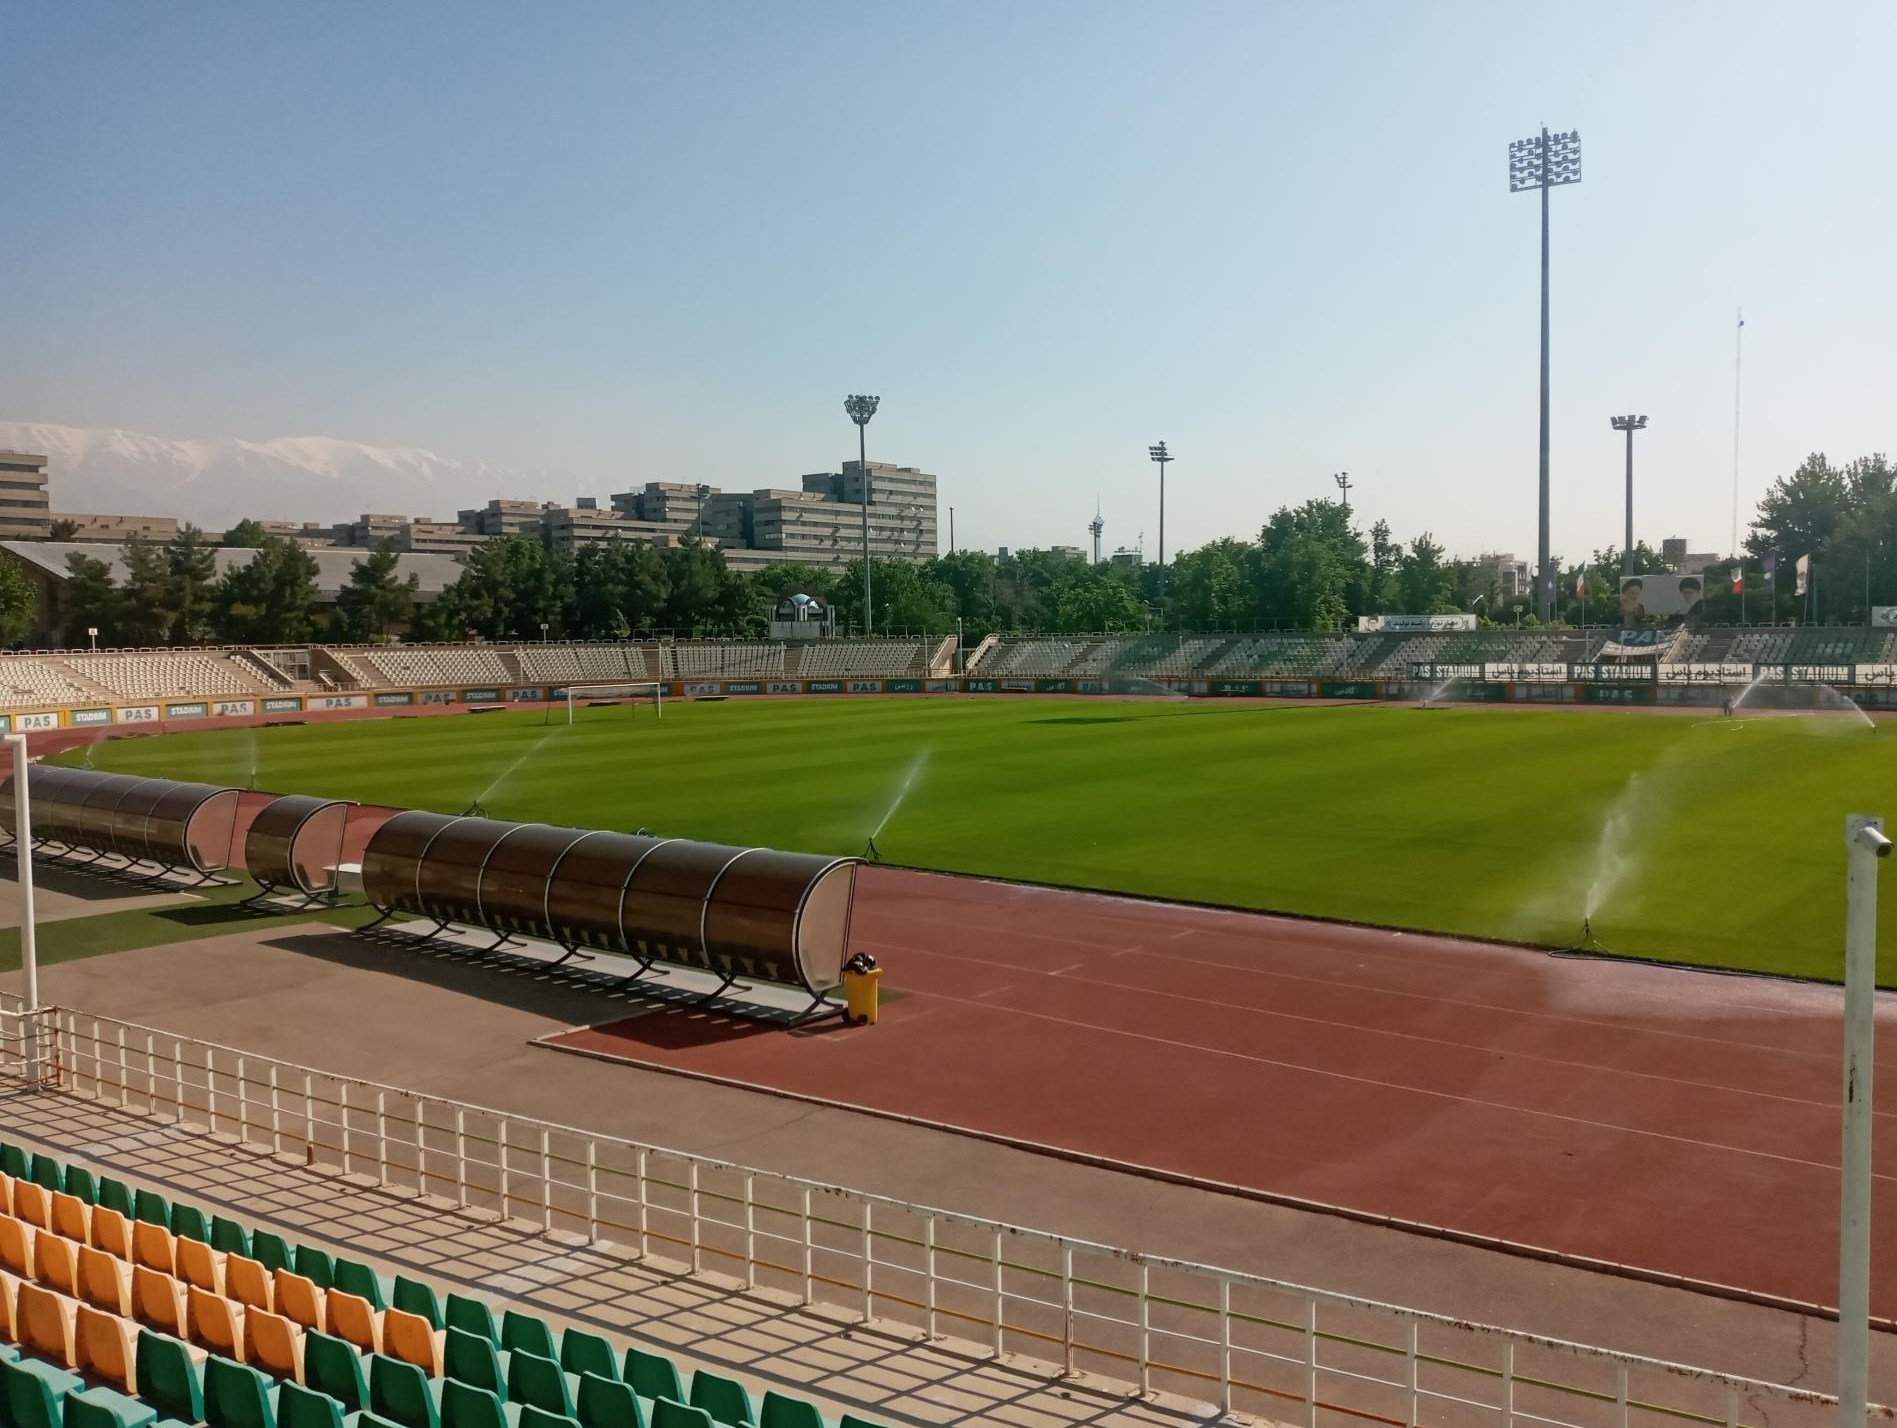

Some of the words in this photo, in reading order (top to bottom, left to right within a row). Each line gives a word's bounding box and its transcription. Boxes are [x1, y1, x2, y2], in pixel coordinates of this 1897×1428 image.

[1412, 665, 1431, 677] PAS
[1436, 665, 1480, 677] STADIUM
[1573, 665, 1596, 679] PAS
[1601, 665, 1652, 679] STADIUM
[1666, 665, 1692, 680] پاس
[1695, 665, 1746, 681] استادیوم
[1759, 666, 1785, 680] PAS
[1791, 666, 1849, 681] STADIUM
[772, 684, 797, 693] PAS
[852, 682, 877, 692] PAS
[969, 681, 993, 691] PAS
[424, 692, 451, 703] PAS
[511, 690, 538, 699] PAS
[220, 702, 247, 714] PAS
[265, 701, 297, 710] STADIUM
[325, 697, 352, 708] PAS
[125, 708, 152, 720] PAS
[170, 706, 202, 716] STADIUM
[24, 716, 51, 728] PAS
[75, 712, 107, 722] STADIUM
